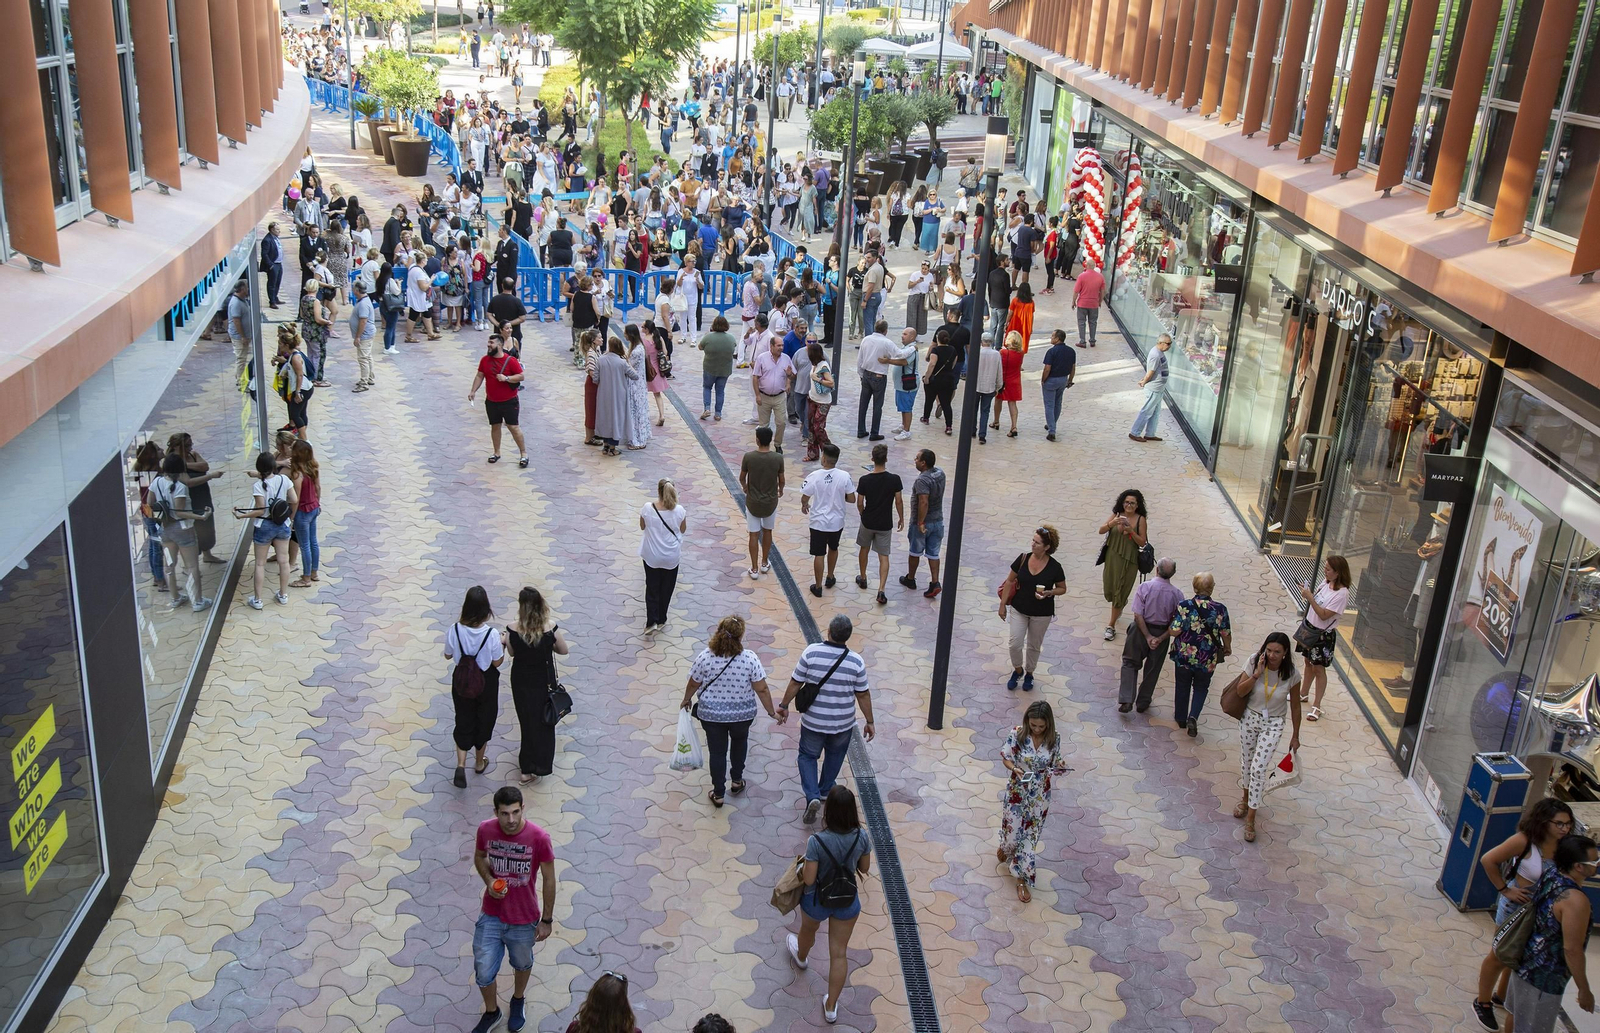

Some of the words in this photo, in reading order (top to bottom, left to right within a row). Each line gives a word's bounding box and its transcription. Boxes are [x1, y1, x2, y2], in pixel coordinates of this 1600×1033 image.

[1321, 277, 1377, 337] PARFOS
[1431, 474, 1464, 482] MARYPAZ
[1493, 496, 1535, 545] Bienvenida
[1482, 595, 1511, 637] 20%
[16, 735, 36, 767] we
[18, 763, 40, 800] are
[14, 793, 43, 838] who
[26, 818, 46, 852] we
[28, 844, 49, 881] are
